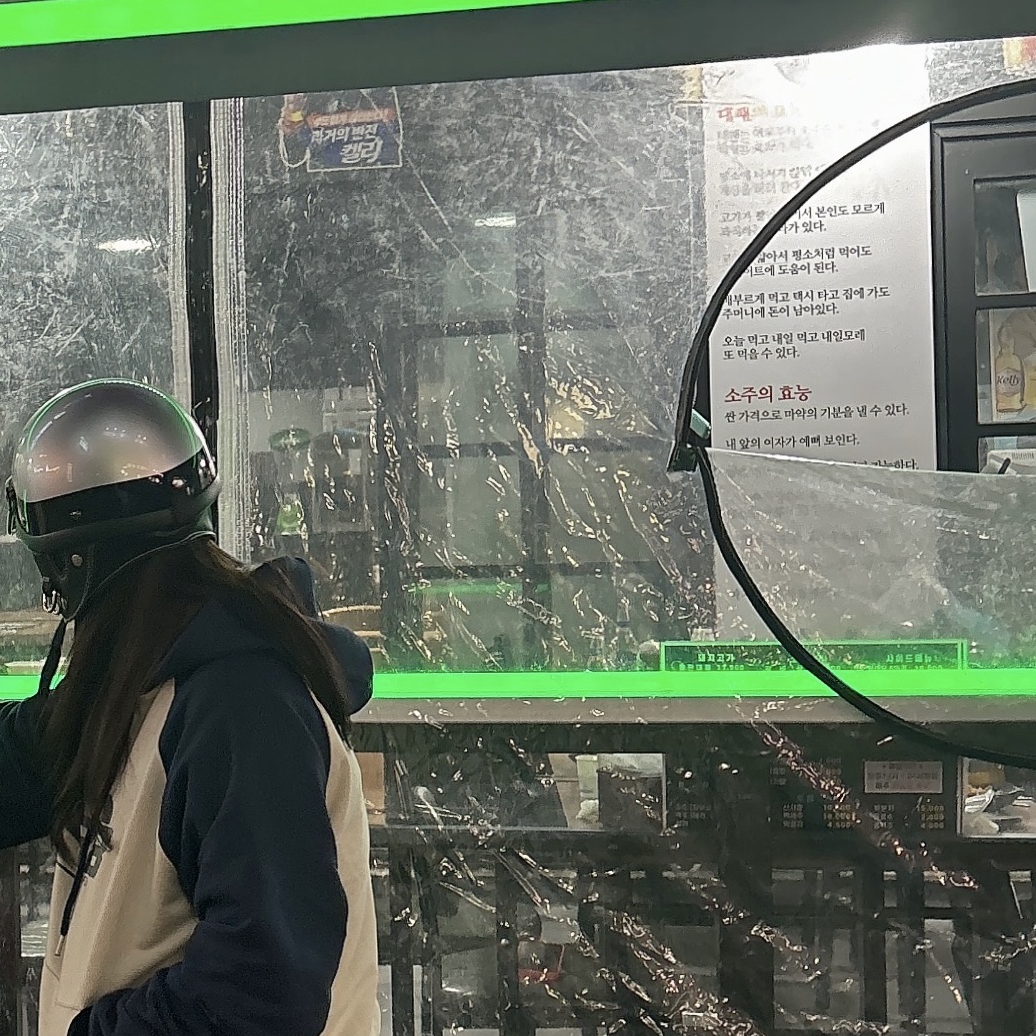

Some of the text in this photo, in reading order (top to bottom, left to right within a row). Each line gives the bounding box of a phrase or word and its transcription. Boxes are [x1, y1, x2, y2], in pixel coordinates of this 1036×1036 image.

[815, 205, 849, 218] 본인도
[851, 202, 885, 215] 모르게
[802, 220, 827, 233] 있다.
[792, 247, 836, 261] 평소처럼
[839, 246, 873, 258] 먹어도
[778, 262, 810, 275] 도움이
[814, 261, 839, 274] 된다.
[768, 292, 790, 304] 먹고
[793, 290, 814, 302] 택시
[817, 290, 840, 301] 타고
[842, 287, 865, 300] 집에
[867, 286, 890, 298] 가도
[722, 303, 839, 320] 주머니에 돈이 남아있다.
[723, 329, 865, 347] 오늘 먹고 내일 먹고 내일모레
[723, 346, 800, 360] 또 먹을 수 있다.
[997, 374, 1019, 387] Kelly
[724, 384, 812, 403] 소주의 효능
[724, 403, 910, 423] 싼 가격으로 마약의 기분을 낼 수 있다.
[726, 438, 736, 450] 내
[739, 437, 761, 449] 앞의
[824, 433, 860, 446] 보인다.
